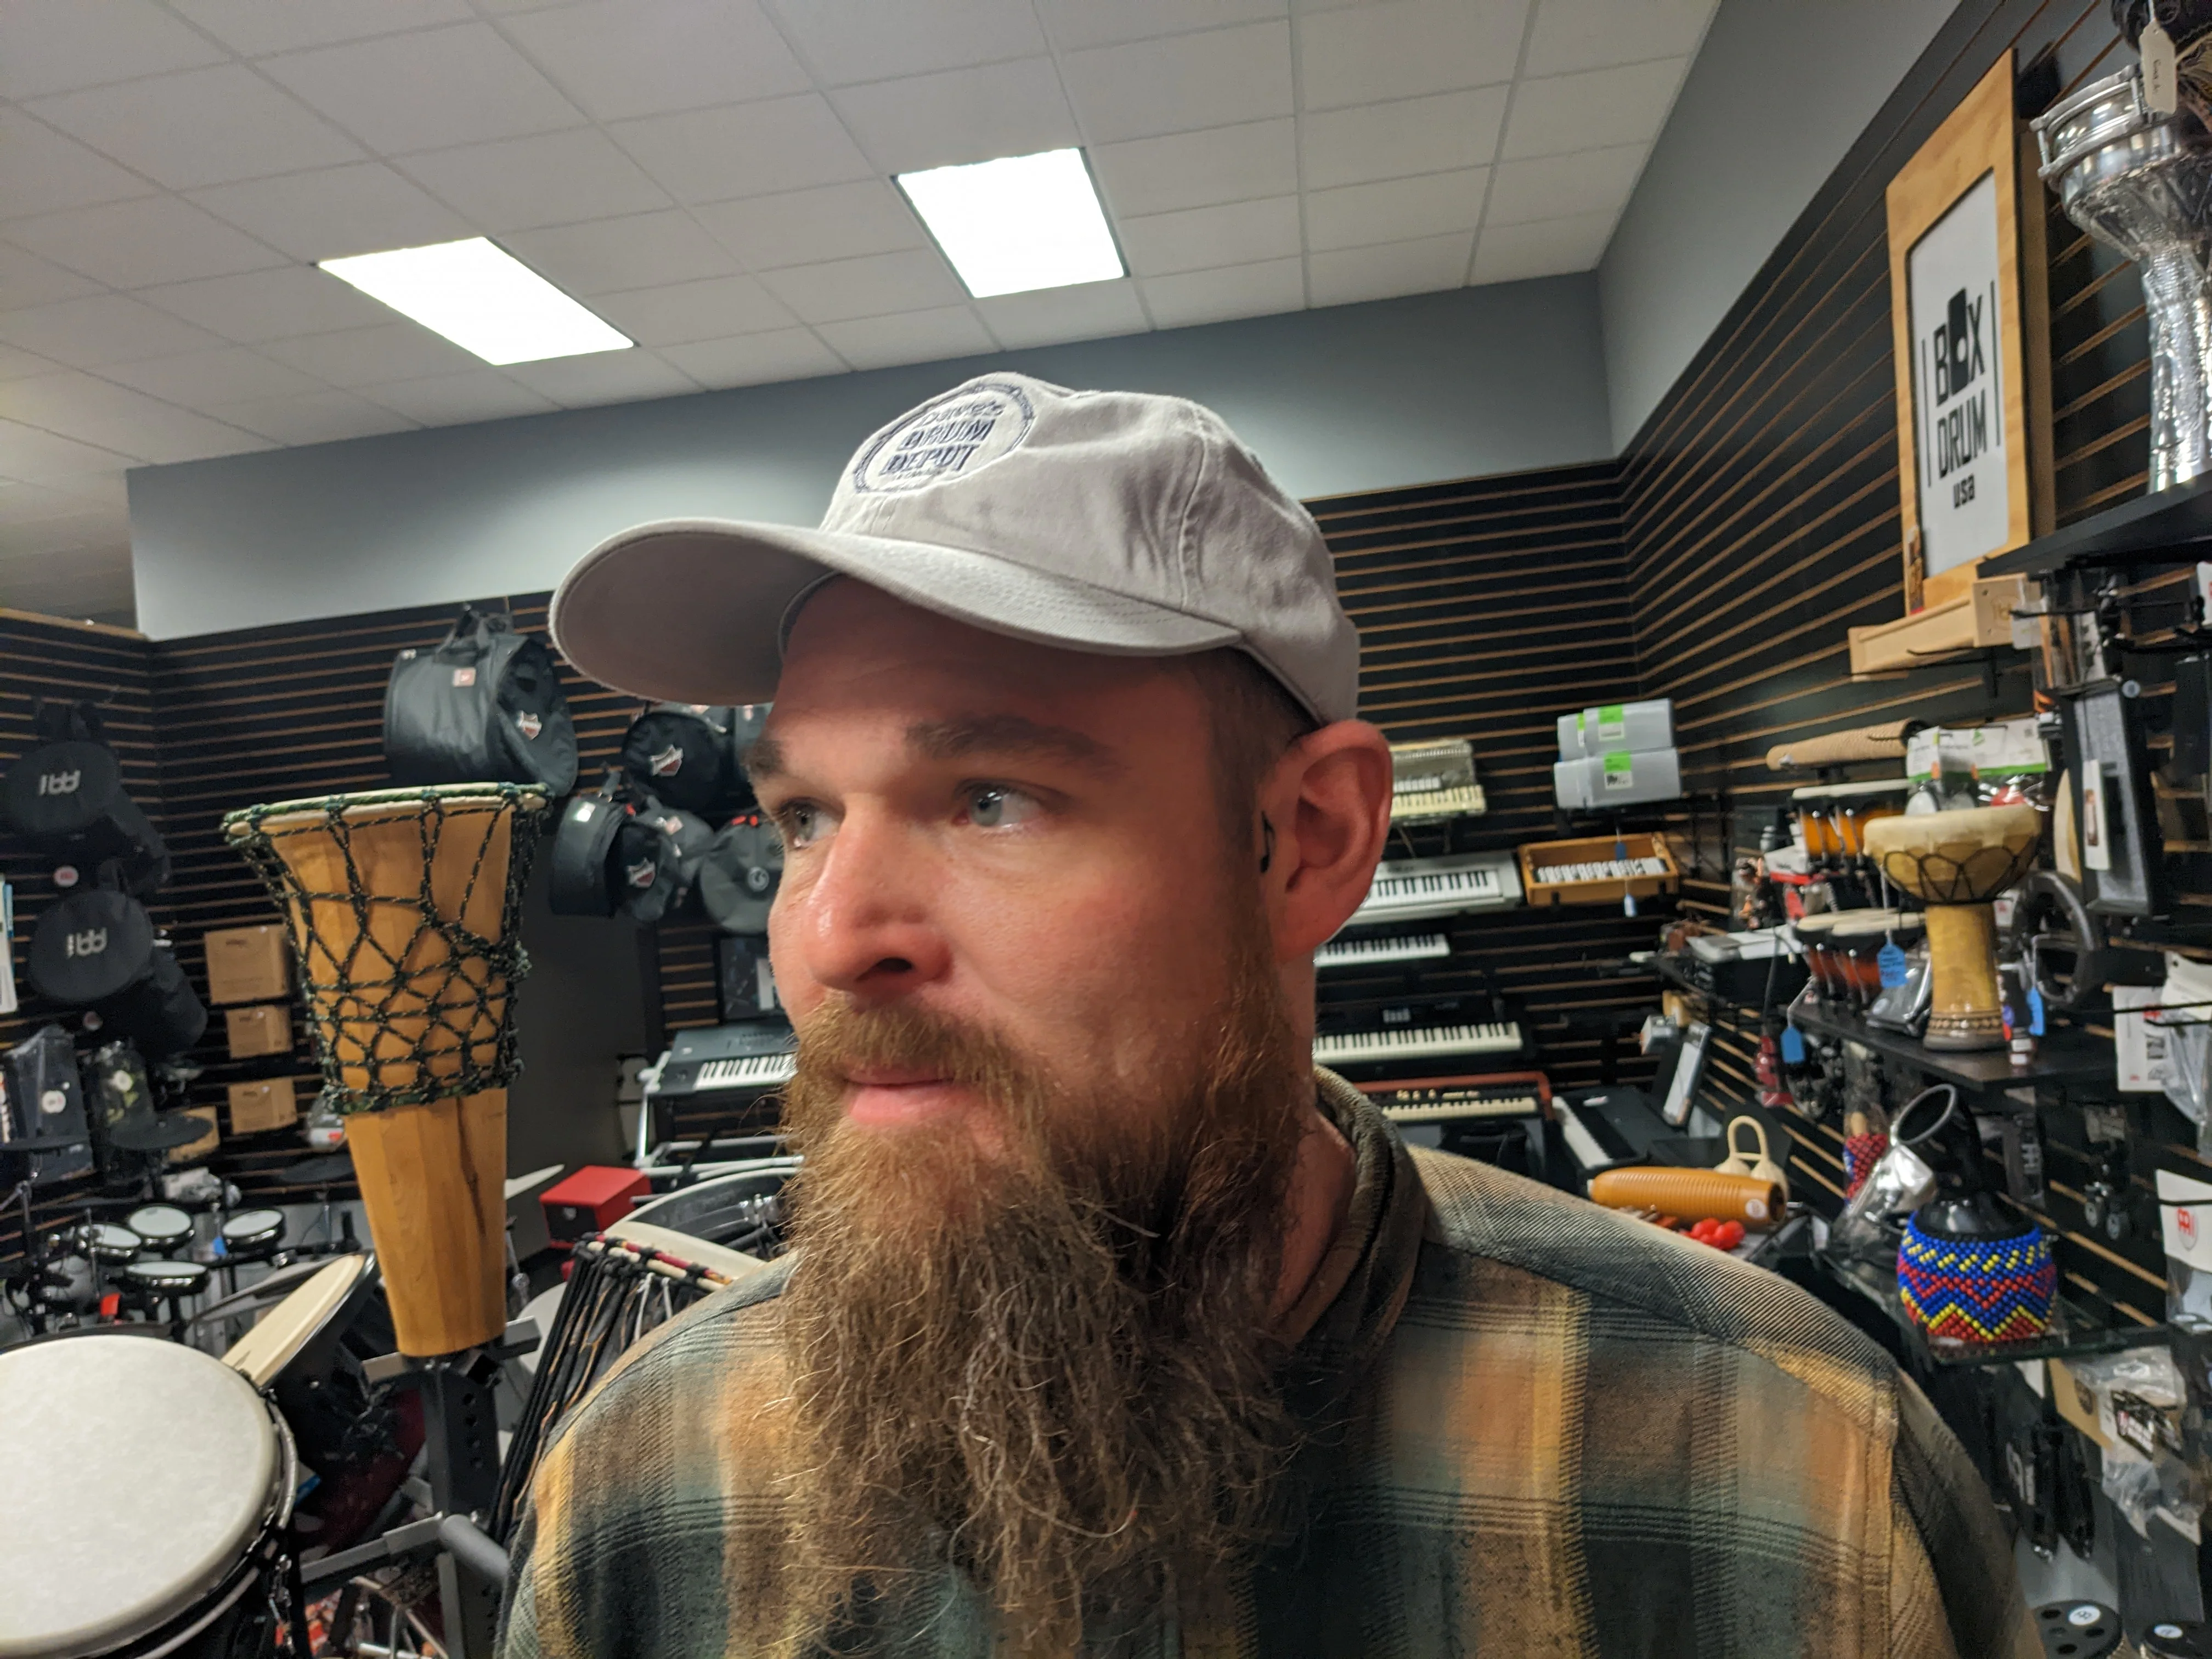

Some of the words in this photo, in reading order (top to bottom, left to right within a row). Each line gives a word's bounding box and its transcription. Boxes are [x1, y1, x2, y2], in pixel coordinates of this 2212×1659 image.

[1933, 287, 1985, 407] BOX
[879, 444, 980, 475] DEPOT
[897, 419, 996, 451] DRUM
[1937, 387, 1988, 479] DRUM
